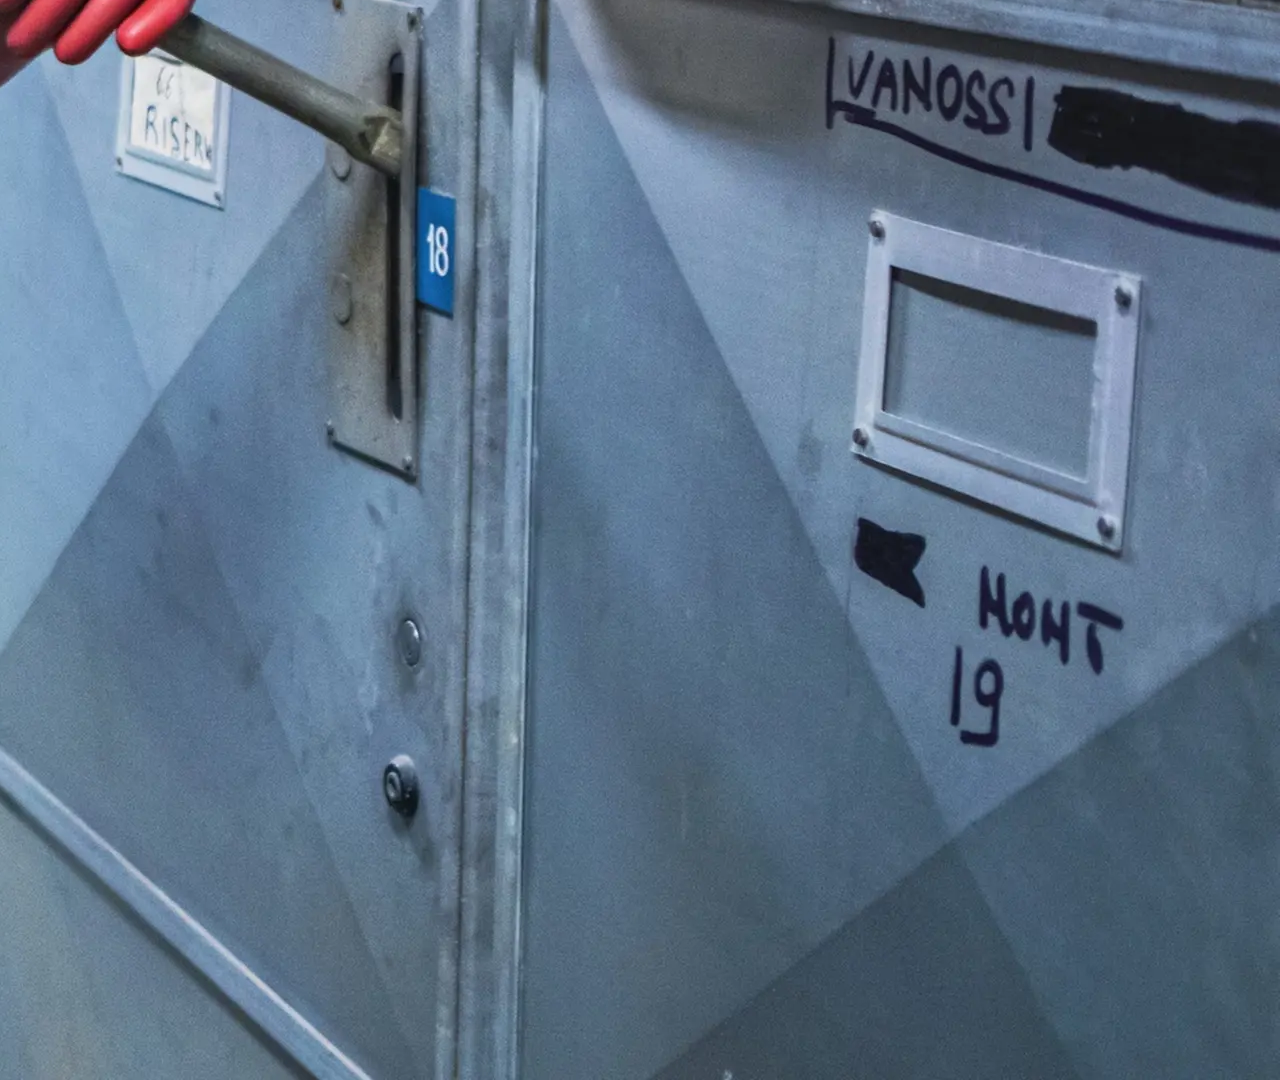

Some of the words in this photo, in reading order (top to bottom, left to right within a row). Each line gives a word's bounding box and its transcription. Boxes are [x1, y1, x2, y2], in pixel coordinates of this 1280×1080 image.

[848, 50, 1035, 152] VANOSSI
[427, 223, 449, 277] 18
[950, 646, 1005, 747] 19
